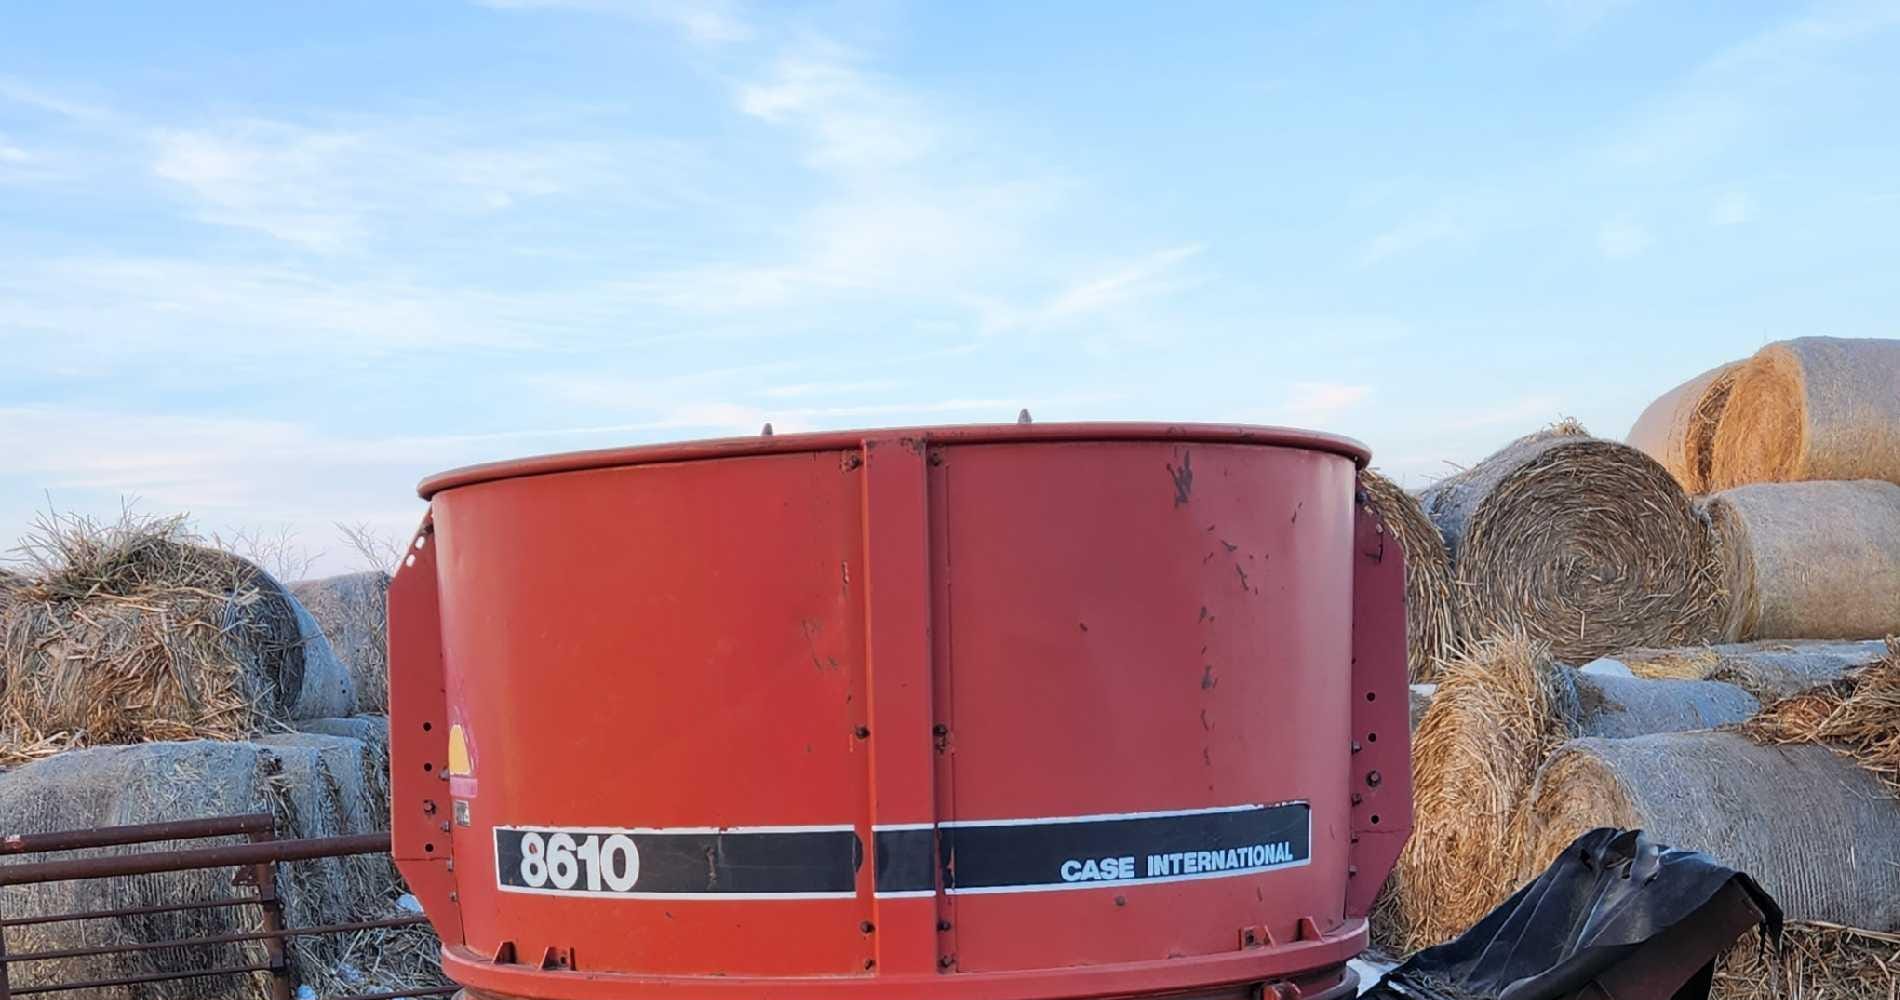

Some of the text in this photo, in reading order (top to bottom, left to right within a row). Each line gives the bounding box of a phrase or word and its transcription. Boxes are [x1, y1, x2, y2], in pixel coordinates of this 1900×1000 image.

[521, 833, 640, 892] 8610
[1061, 842, 1293, 882] CASE INTERNATIONAL
